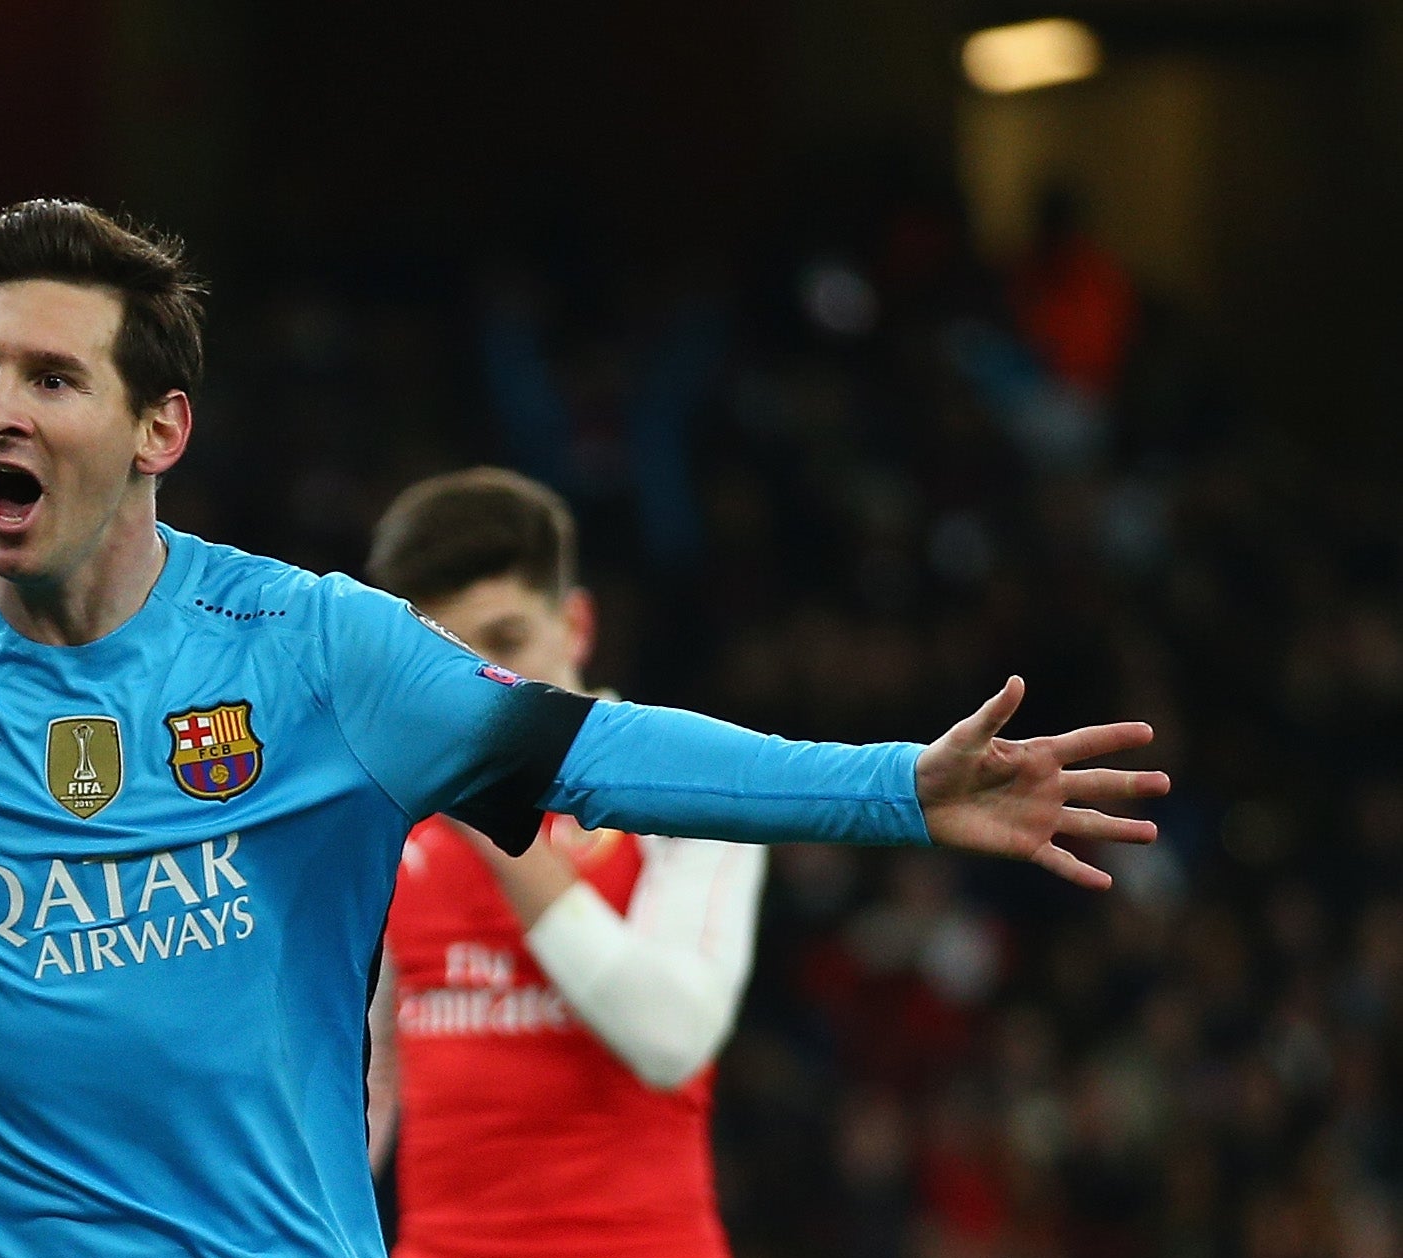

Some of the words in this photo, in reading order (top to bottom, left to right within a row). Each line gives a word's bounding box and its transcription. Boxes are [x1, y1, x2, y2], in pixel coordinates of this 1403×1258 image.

[198, 744, 232, 759] FCB
[68, 782, 102, 795] FIFA
[74, 800, 94, 808] 2015
[34, 895, 255, 980] AIRWAYS
